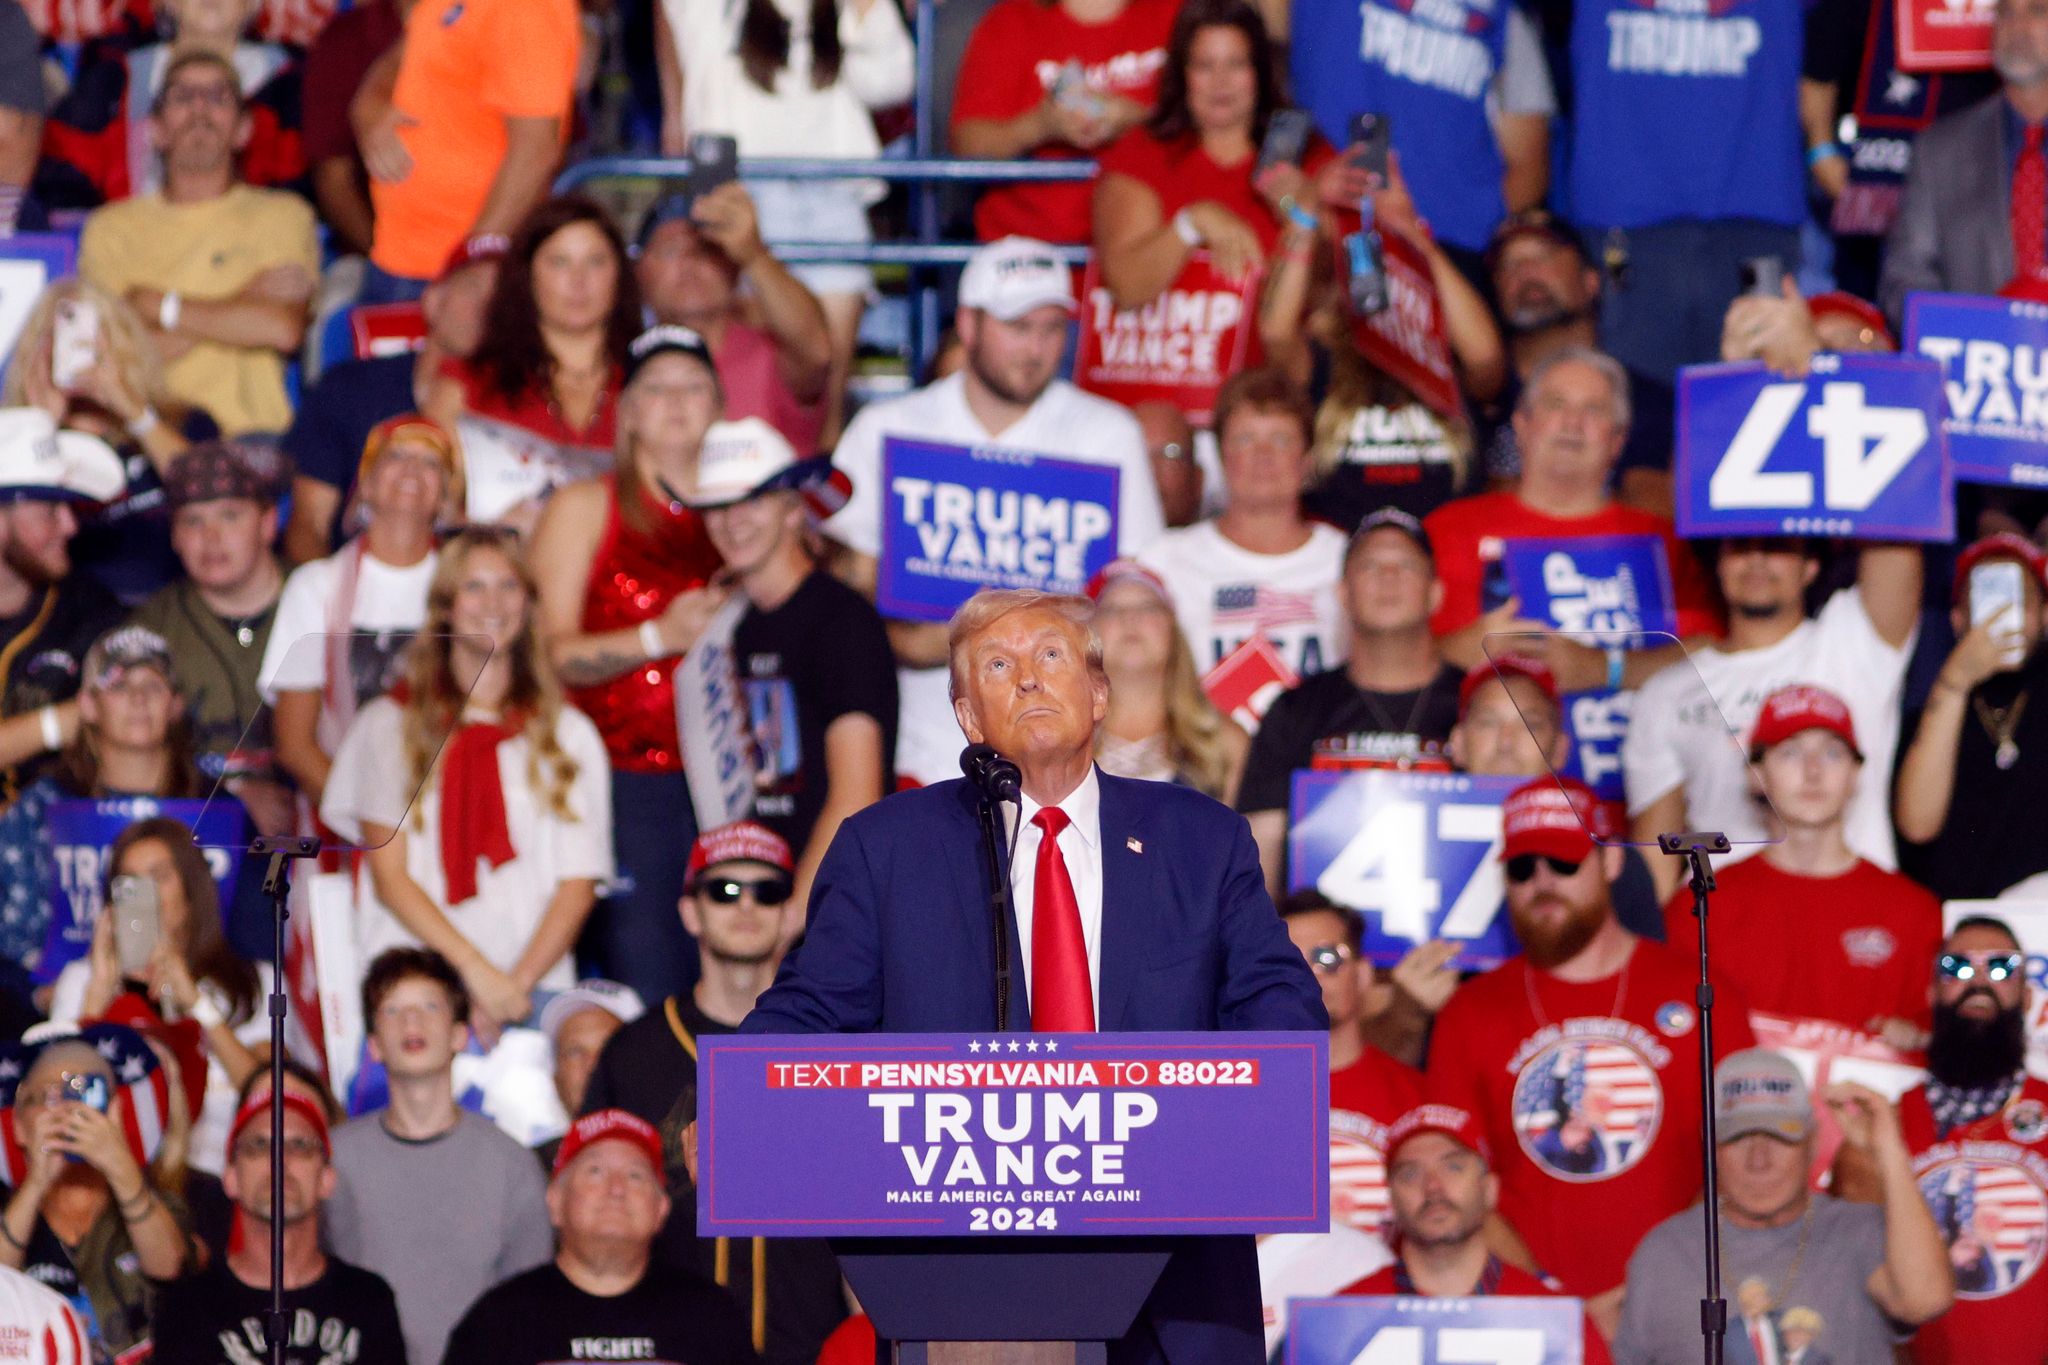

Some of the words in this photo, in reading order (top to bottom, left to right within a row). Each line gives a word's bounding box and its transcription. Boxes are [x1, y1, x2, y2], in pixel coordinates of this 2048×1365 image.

[1360, 2, 1494, 100] TRUMP
[1606, 11, 1761, 77] TRUMP
[1101, 329, 1218, 372] VANCE
[1710, 382, 1928, 510] 47
[891, 476, 1112, 544] TRUMP
[917, 522, 1087, 582] VANCE
[1316, 802, 1504, 945] 47
[773, 1063, 852, 1087] TEXT
[861, 1062, 1100, 1087] PENNSYLVANIA
[1107, 1061, 1149, 1086] TO
[1158, 1061, 1253, 1086] 88022
[868, 1091, 1159, 1144] TRUMP
[901, 1143, 1125, 1187] VANCE
[886, 1190, 934, 1203] MAKE
[938, 1190, 1016, 1203] AMERICA
[1020, 1189, 1076, 1203] GREAT
[1081, 1189, 1141, 1202] AGAIN!
[969, 1207, 1058, 1231] 2024
